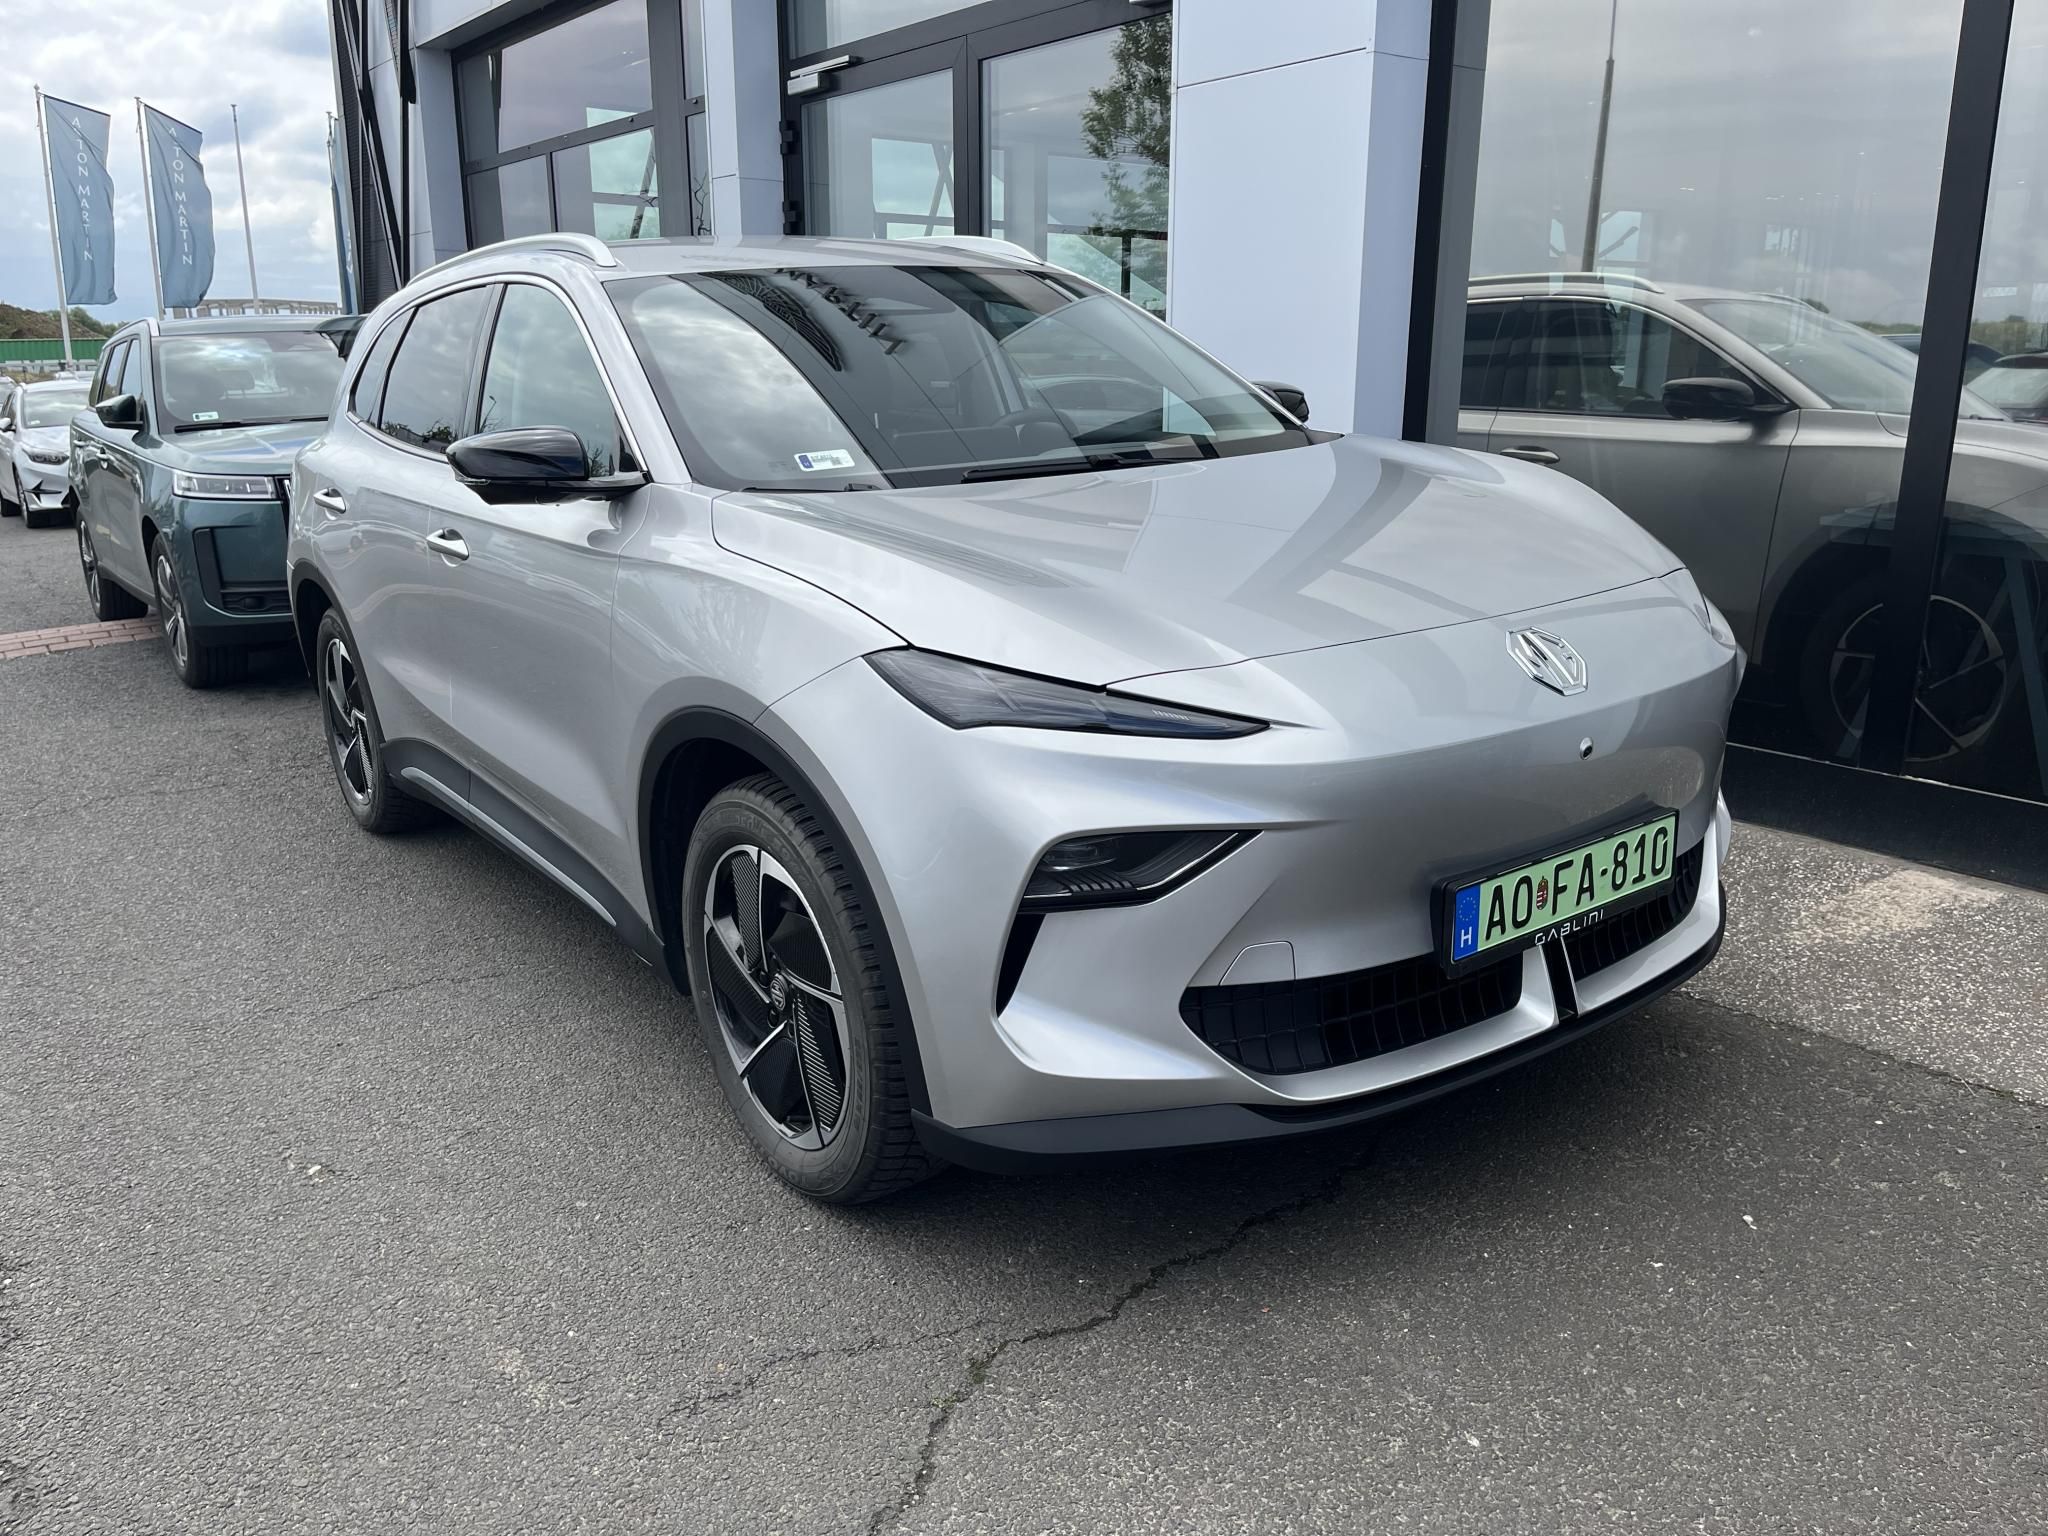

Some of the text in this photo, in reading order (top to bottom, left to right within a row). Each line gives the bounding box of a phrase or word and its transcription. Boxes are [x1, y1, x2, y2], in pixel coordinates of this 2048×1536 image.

[77, 184, 94, 261] MARTIN
[168, 127, 193, 265] ATON MARTIN
[1460, 926, 1473, 949] H
[1535, 908, 1604, 946] GABLINI
